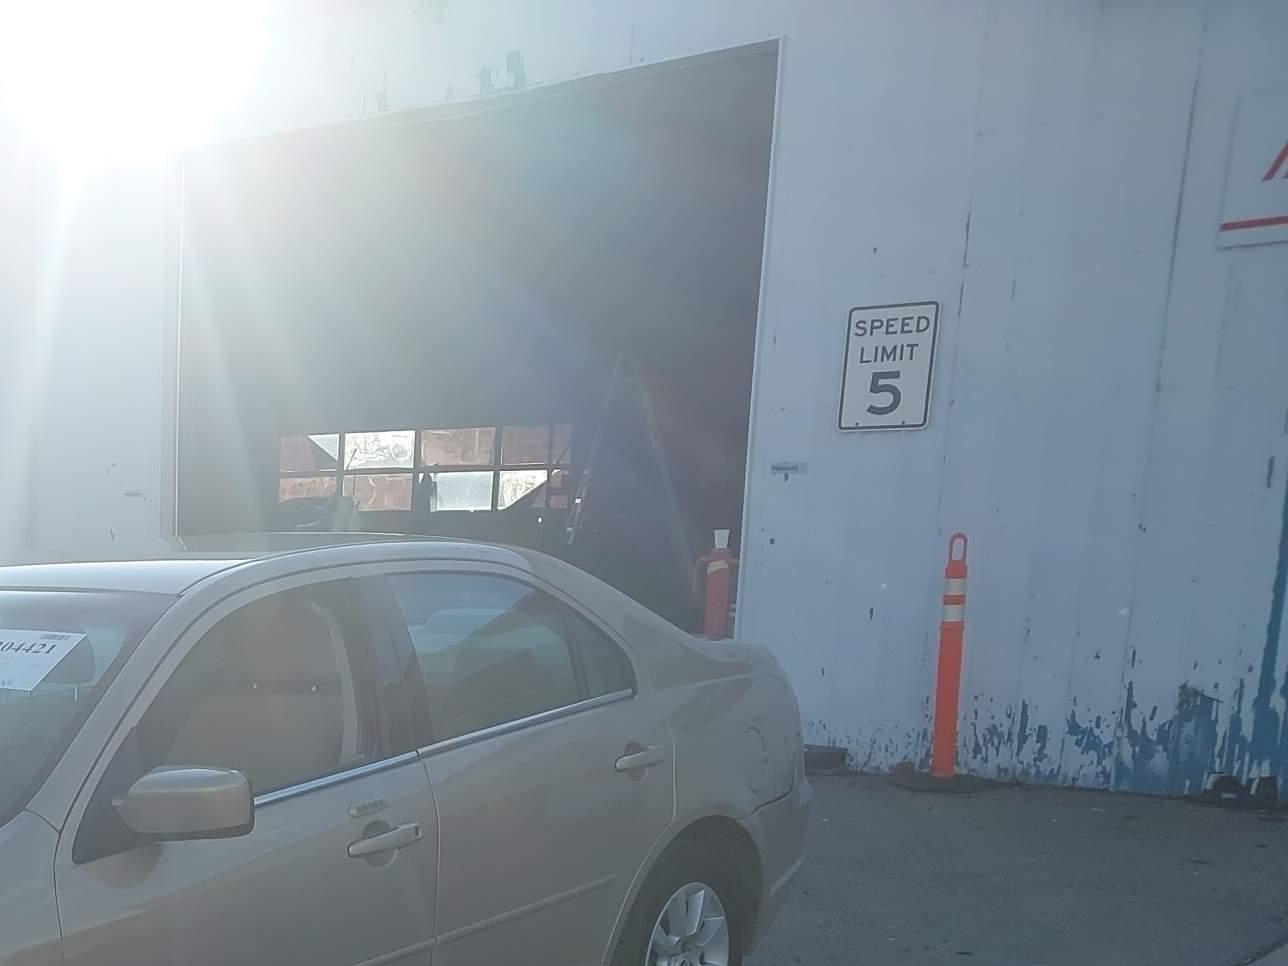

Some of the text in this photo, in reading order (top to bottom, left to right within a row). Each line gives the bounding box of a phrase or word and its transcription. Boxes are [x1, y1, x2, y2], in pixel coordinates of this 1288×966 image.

[854, 315, 931, 337] SPEED
[859, 343, 919, 364] LIMIT
[866, 370, 902, 416] 5
